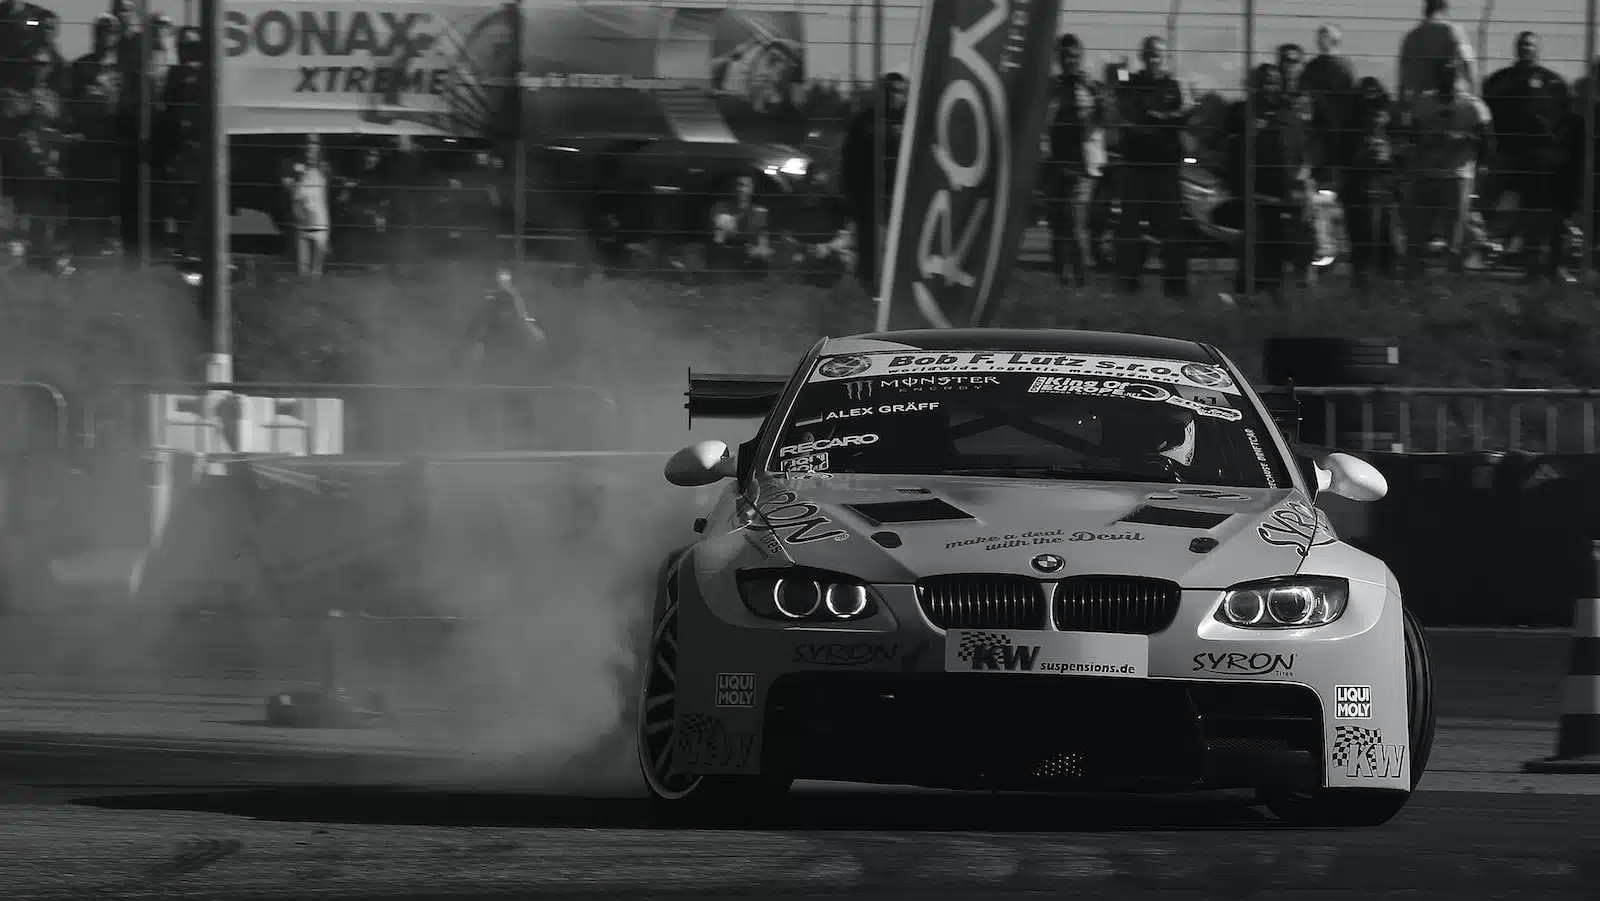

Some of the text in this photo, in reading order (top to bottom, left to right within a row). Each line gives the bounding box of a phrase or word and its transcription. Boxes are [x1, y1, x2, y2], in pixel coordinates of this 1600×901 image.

[222, 10, 432, 57] SONAX
[888, 353, 1180, 377] Bob F. Lutz s.r.o.
[888, 365, 979, 374] worldwide
[1069, 368, 1181, 383] management
[880, 376, 1000, 388] MONSTER
[1043, 377, 1099, 388] King
[826, 401, 940, 420] ALEX GRÄFF
[779, 433, 880, 458] RECARO
[944, 535, 1000, 550] make
[1021, 528, 1065, 538] deal
[985, 531, 1146, 552] with the Devil
[791, 643, 899, 667] SYRON
[970, 644, 1136, 675] KW suspensions.de
[1192, 652, 1295, 676] SYRON
[719, 675, 754, 690] LIQUI
[718, 691, 754, 705] MOLY
[1337, 687, 1370, 702] LIQUI
[1337, 703, 1371, 717] MOLY
[1345, 744, 1405, 778] KW
